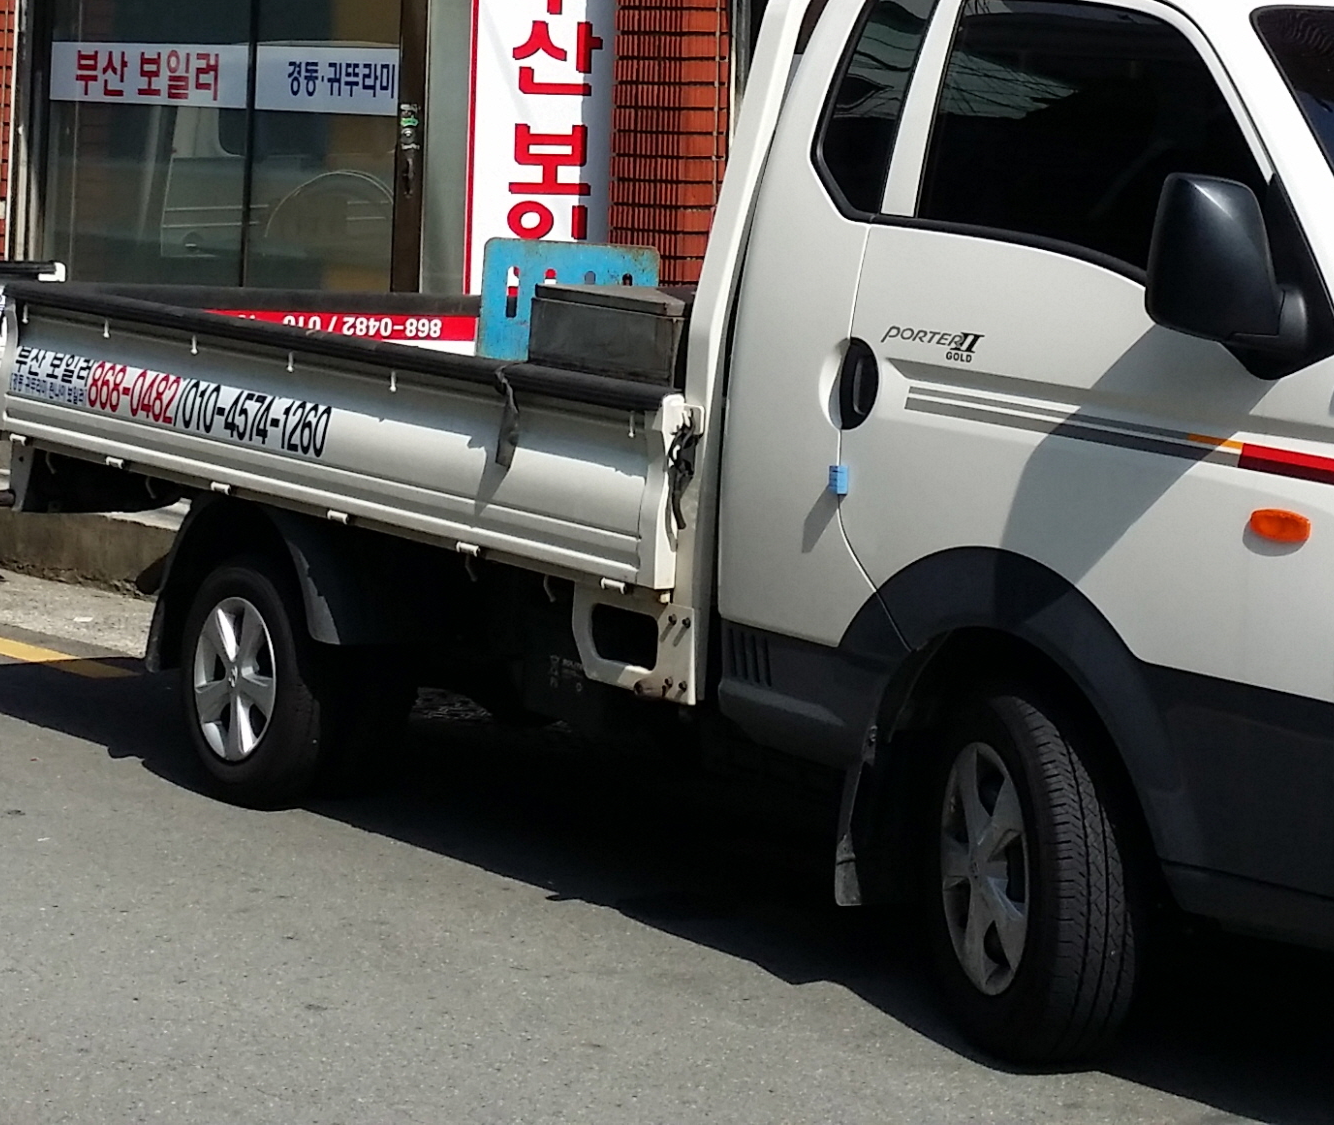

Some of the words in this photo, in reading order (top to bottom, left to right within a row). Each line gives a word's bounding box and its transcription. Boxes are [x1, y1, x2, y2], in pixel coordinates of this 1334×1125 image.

[75, 49, 128, 97] 부산
[137, 49, 220, 101] 보일러
[880, 325, 964, 348] PORTER
[15, 346, 46, 377] 부산
[46, 353, 97, 387] 보일러
[945, 351, 972, 363] GOLD
